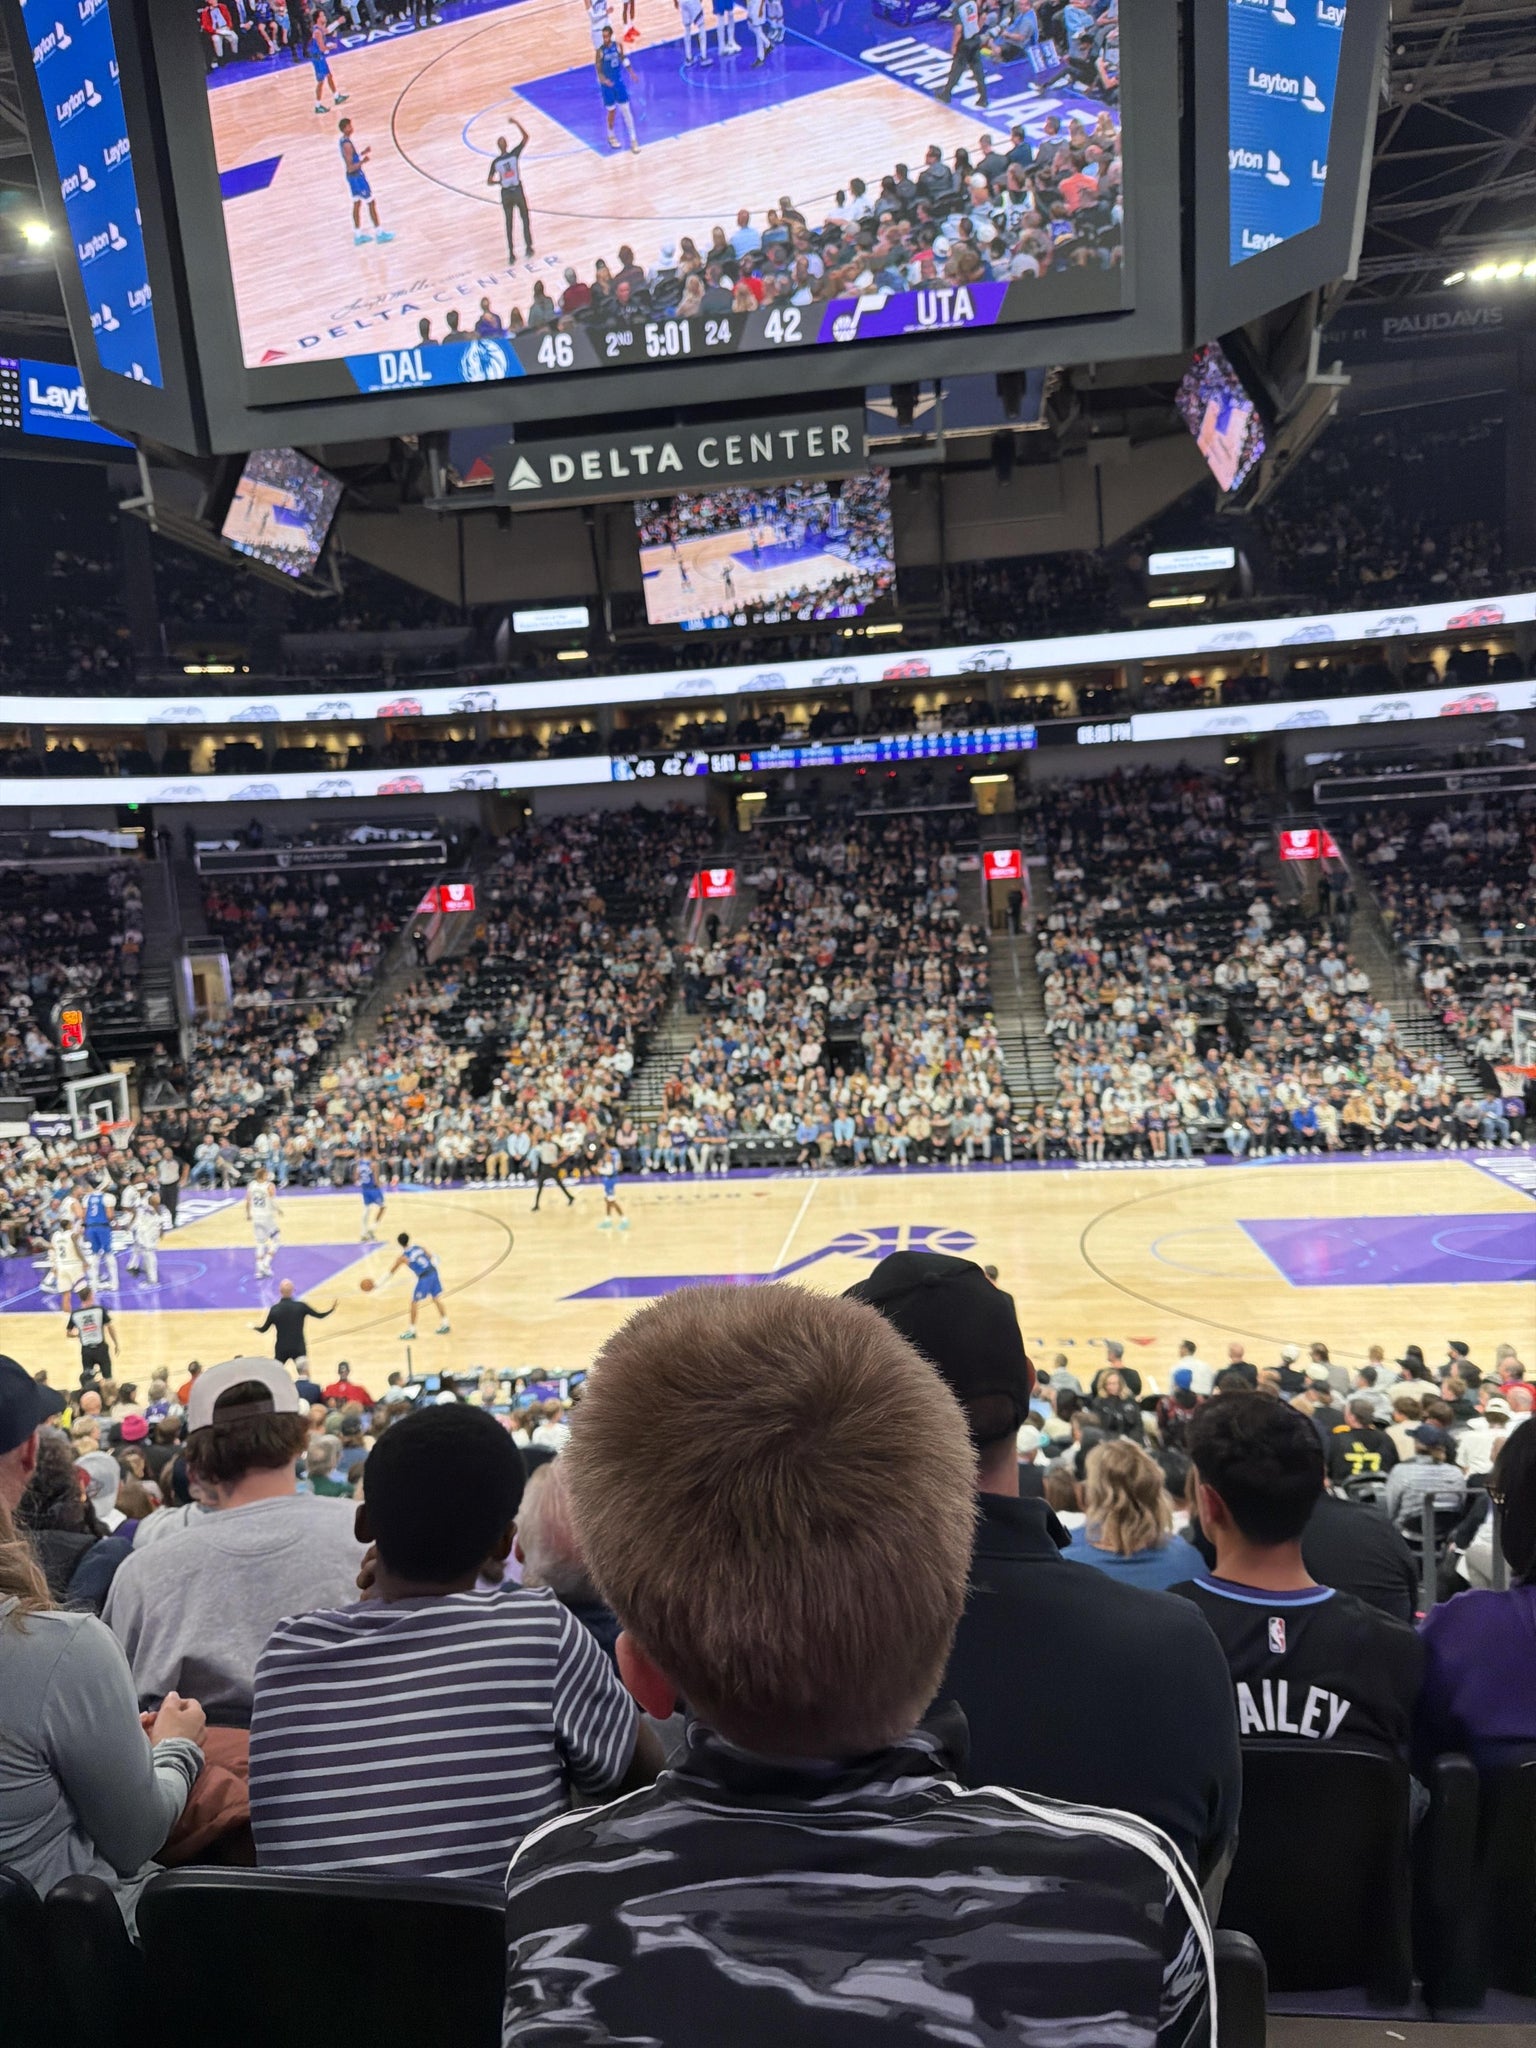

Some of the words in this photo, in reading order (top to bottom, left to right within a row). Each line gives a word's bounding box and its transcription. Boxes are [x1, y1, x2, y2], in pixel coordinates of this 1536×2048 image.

[1317, 0, 1346, 27] Lay
[1248, 67, 1299, 95] Layton
[56, 89, 86, 122] Layton
[78, 231, 110, 261] Layton
[297, 303, 421, 349] DELTA
[432, 254, 562, 302] CENTER
[378, 349, 432, 385] DAL
[537, 332, 574, 368] 46
[645, 320, 691, 357] 5:01
[704, 318, 732, 346] 24
[764, 307, 803, 344] 42
[916, 286, 975, 326] UTA
[549, 442, 684, 484] DELTA
[698, 423, 852, 469] CENTER
[1236, 1678, 1352, 1741] AILEY
